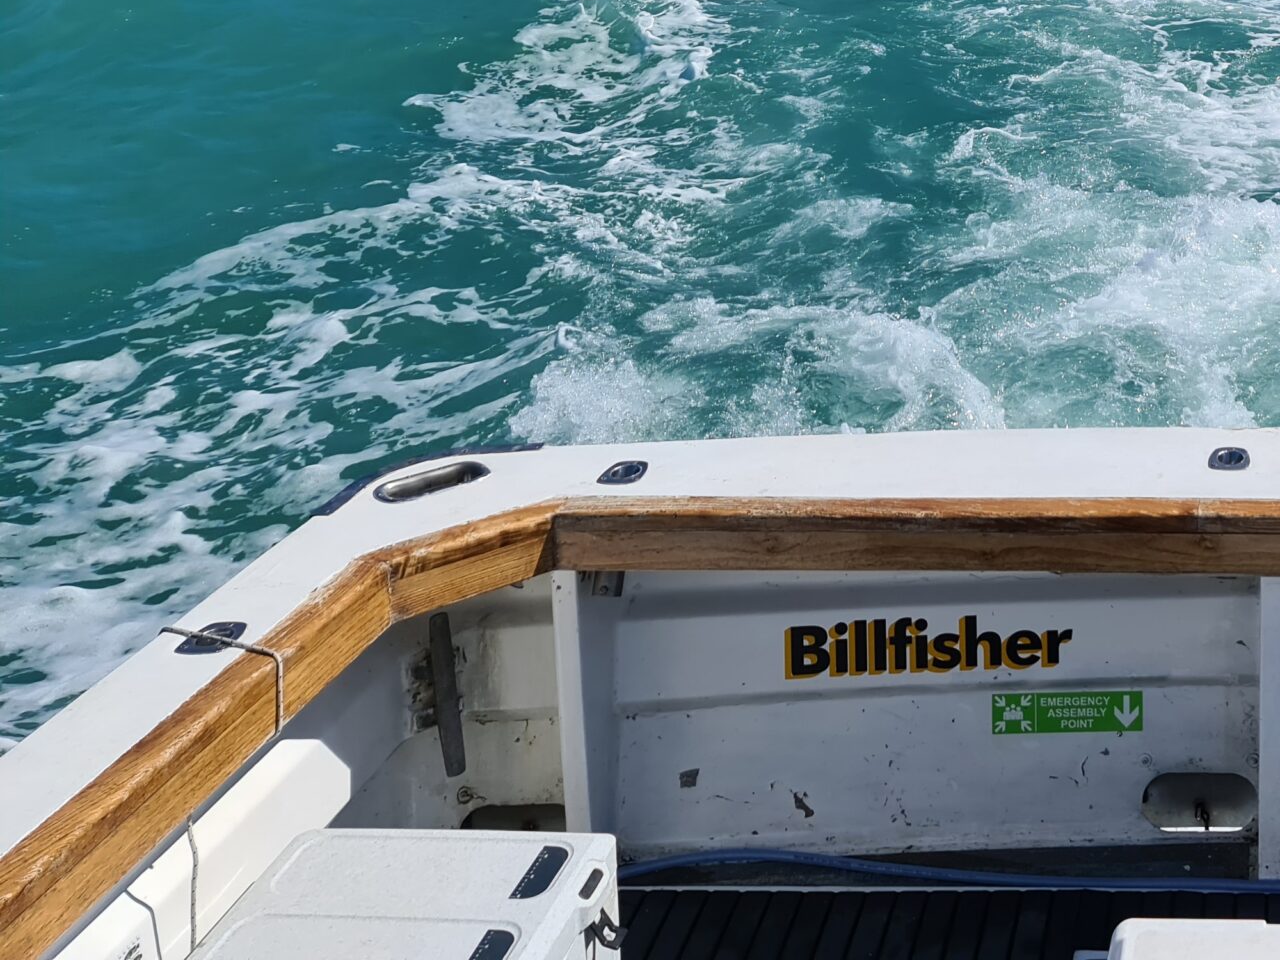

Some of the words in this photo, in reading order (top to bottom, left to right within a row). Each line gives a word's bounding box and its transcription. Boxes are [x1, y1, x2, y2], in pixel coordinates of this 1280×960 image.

[785, 615, 1073, 679] Billfisher
[1040, 696, 1110, 707] EMERGENCY
[1047, 707, 1107, 718] ASSEMBLY
[1060, 719, 1094, 729] POINT
